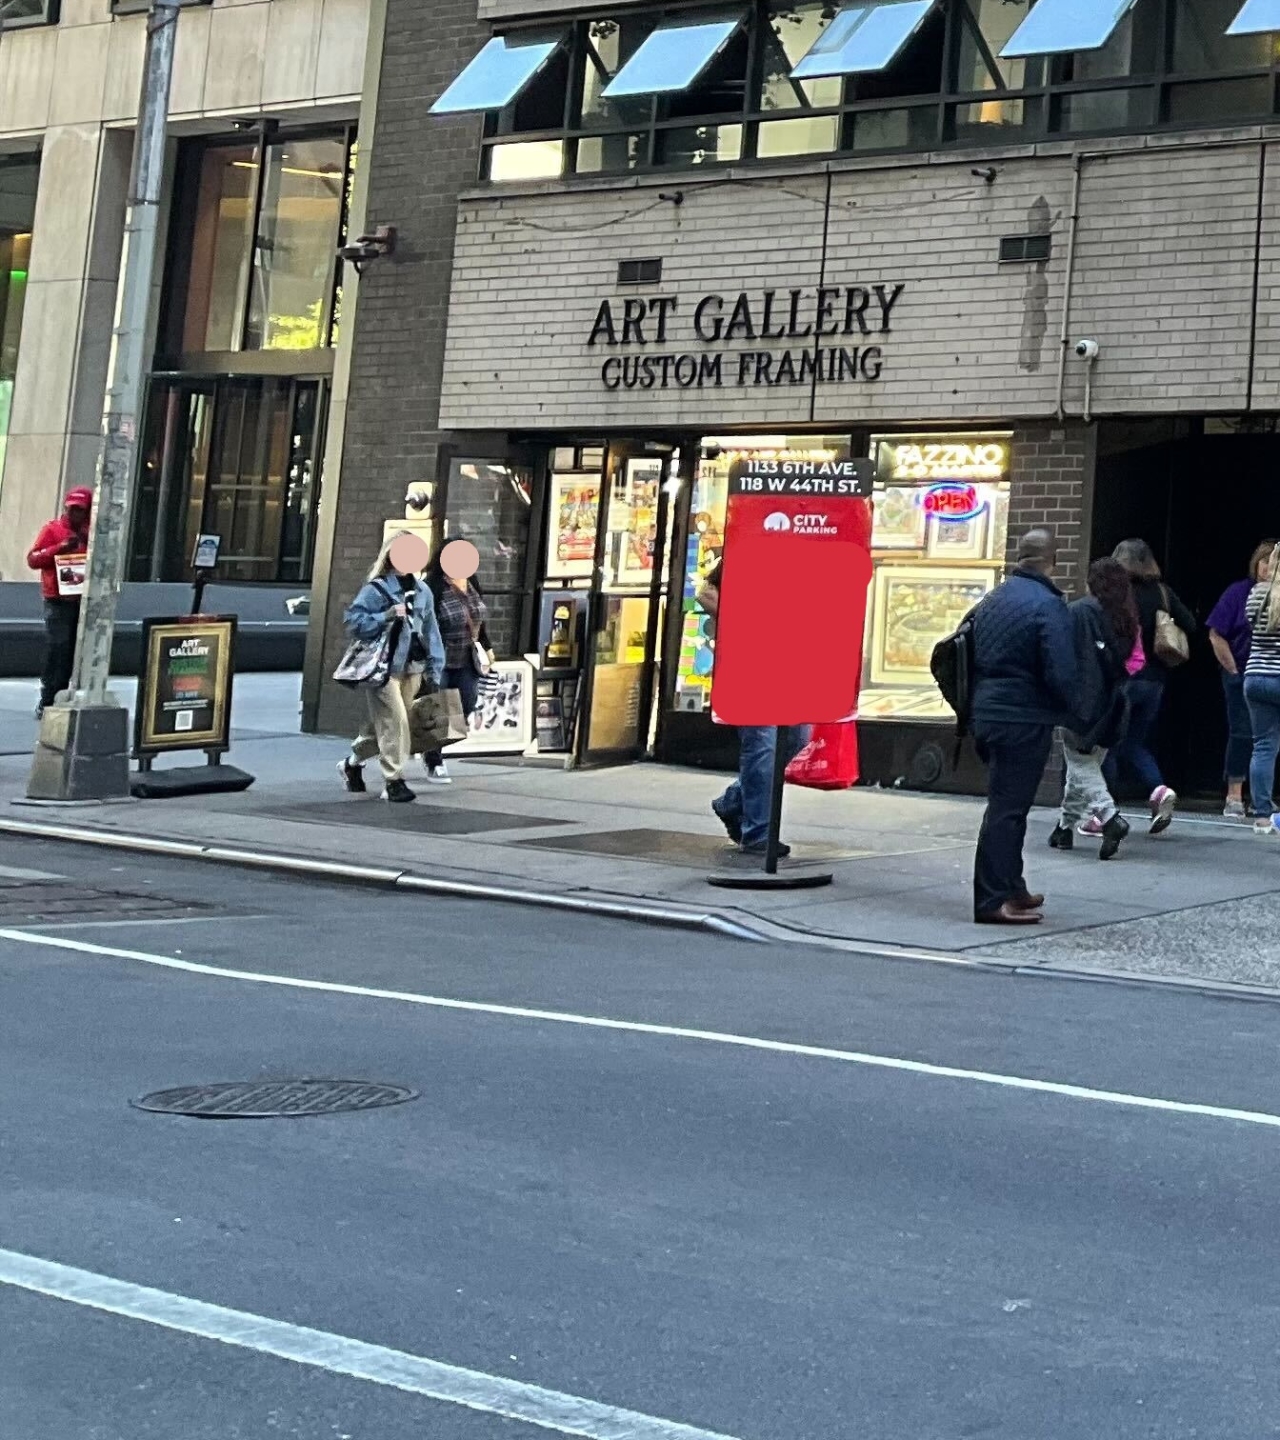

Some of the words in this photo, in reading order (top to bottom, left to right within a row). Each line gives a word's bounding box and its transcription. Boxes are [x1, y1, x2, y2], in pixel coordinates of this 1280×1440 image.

[587, 295, 677, 346] ART
[694, 283, 905, 342] GALLERY
[601, 353, 723, 389] CUSTOM
[737, 346, 883, 386] FRAMING
[896, 443, 1005, 465] FAZZINO
[747, 460, 778, 474] 1133
[782, 460, 815, 475] 6TH
[818, 462, 858, 476] AVE.
[739, 477, 763, 492] 118
[768, 478, 786, 492] W
[790, 478, 833, 493] 44TH
[837, 480, 862, 493] ST.
[924, 486, 977, 513] OPEN
[793, 514, 828, 527] CITY
[793, 526, 838, 534] PARKING
[169, 646, 209, 657] GALLERY
